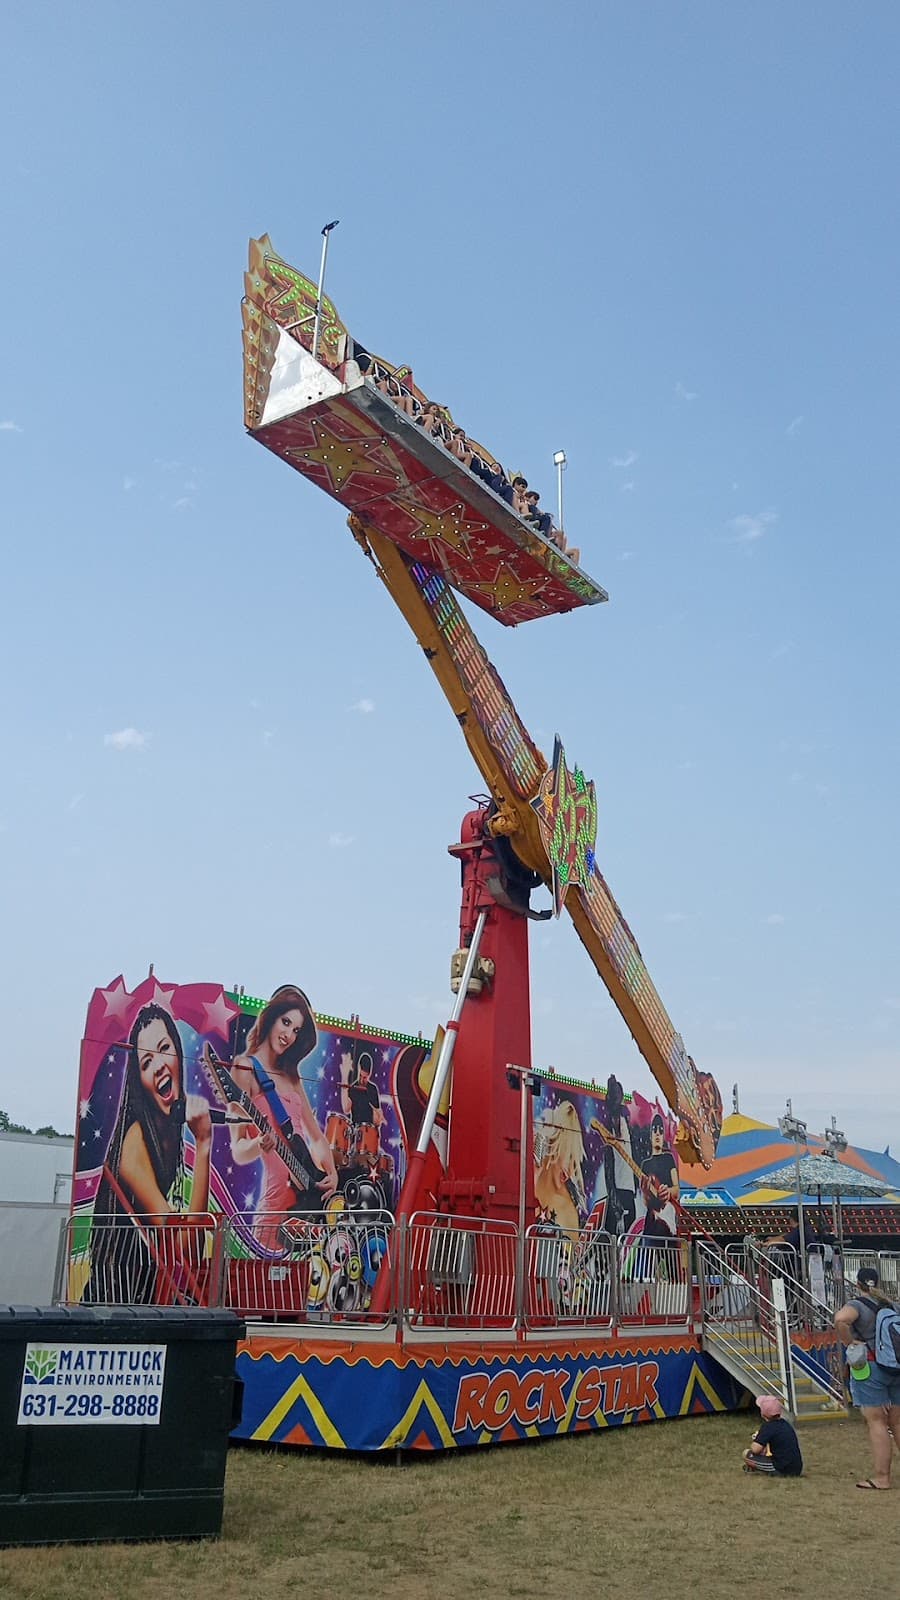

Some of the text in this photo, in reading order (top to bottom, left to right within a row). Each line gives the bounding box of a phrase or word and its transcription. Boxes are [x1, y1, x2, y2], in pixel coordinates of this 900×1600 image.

[58, 1350, 163, 1371] MATTITUCK
[56, 1374, 162, 1386] ENVIRONMENTAL
[22, 1394, 159, 1417] 631-298-8888
[452, 1361, 660, 1433] ROCK STAR
